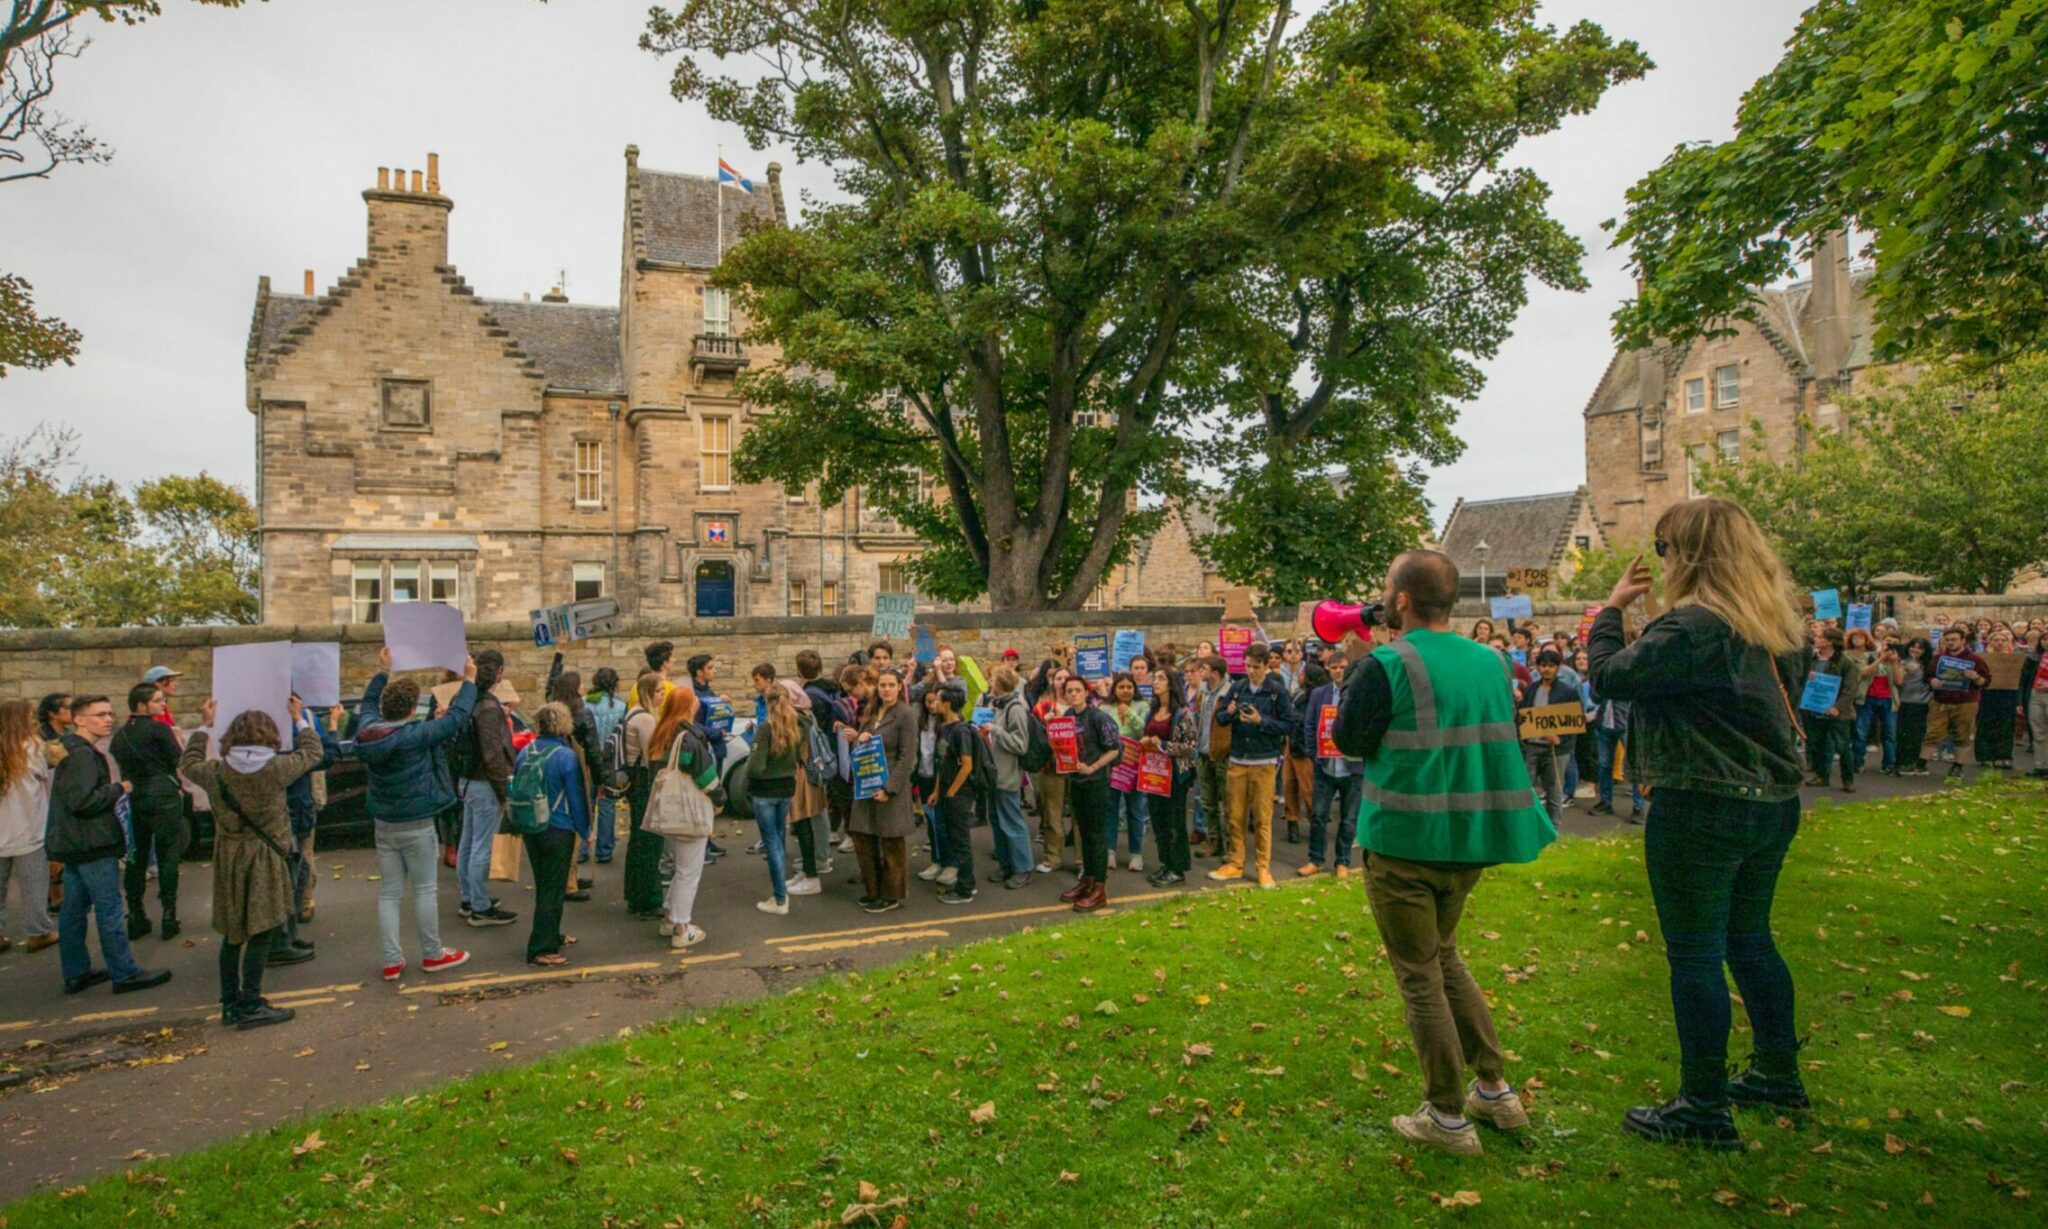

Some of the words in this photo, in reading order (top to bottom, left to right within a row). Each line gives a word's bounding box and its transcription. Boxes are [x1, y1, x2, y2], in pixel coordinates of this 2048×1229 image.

[1524, 568, 1548, 580] FOR
[1525, 580, 1549, 588] WHO
[1535, 715, 1557, 730] FOR
[1557, 713, 1584, 727] WHO
